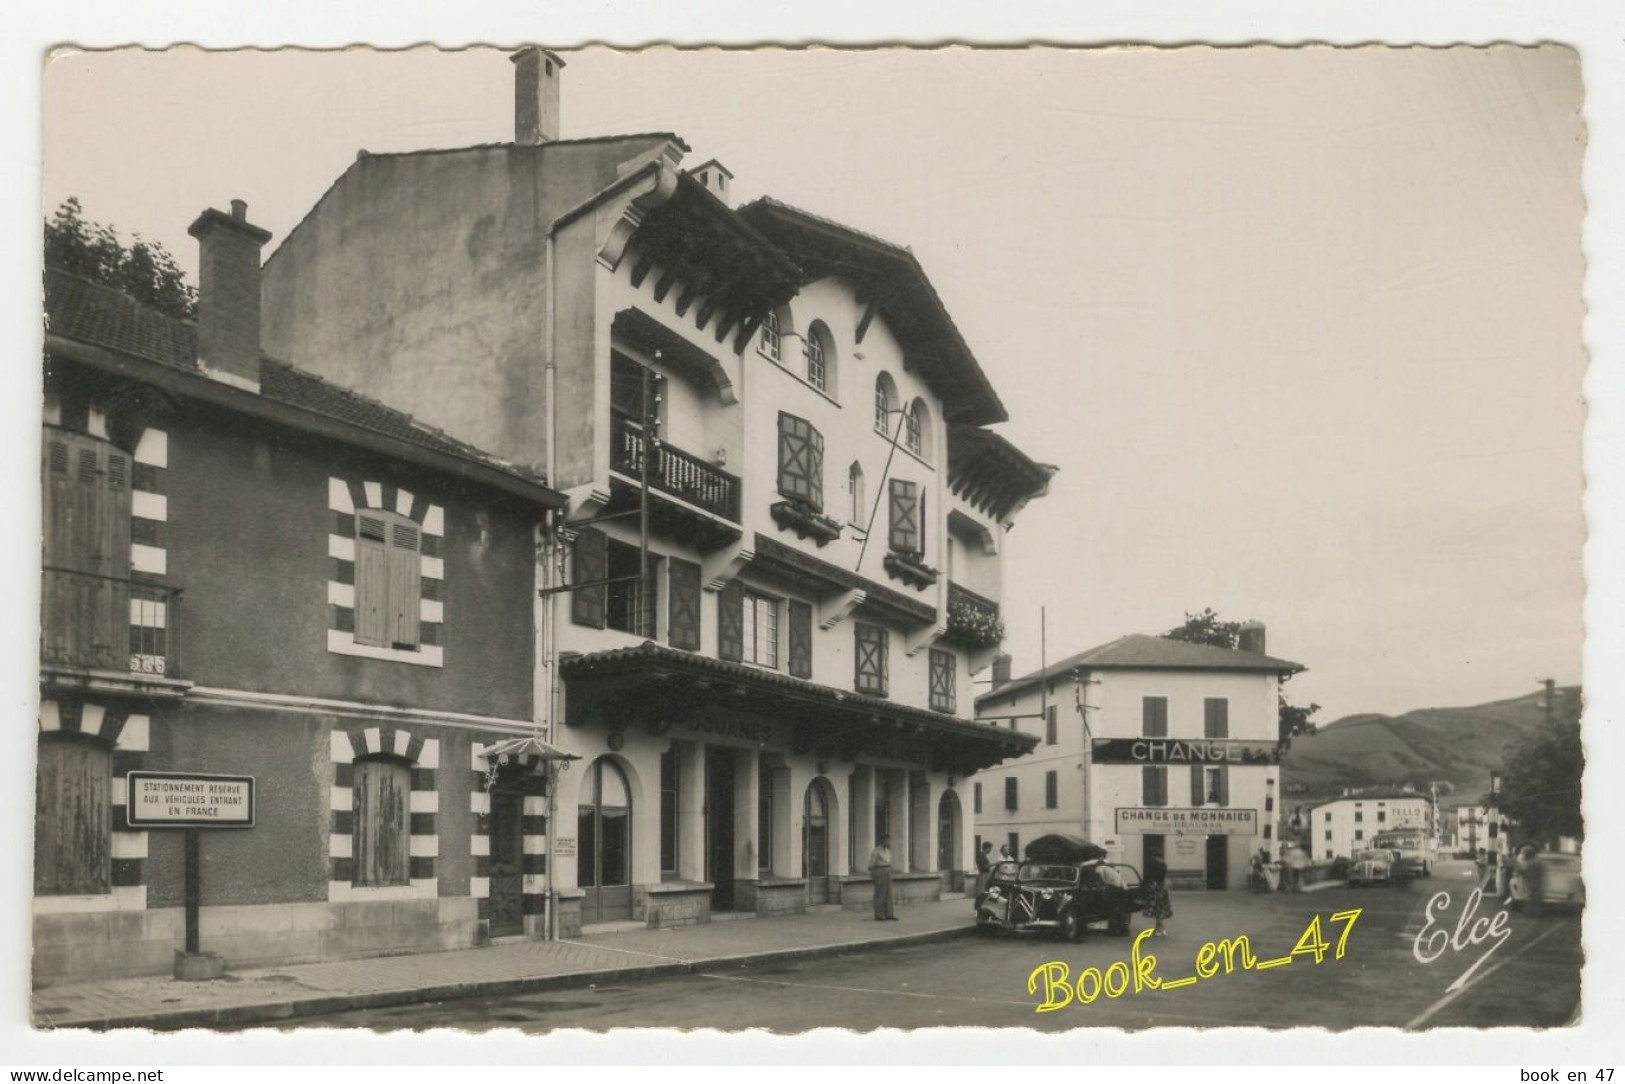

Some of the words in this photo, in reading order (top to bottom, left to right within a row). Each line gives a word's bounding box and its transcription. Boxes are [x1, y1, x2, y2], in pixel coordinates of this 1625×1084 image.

[1131, 741, 1242, 761] CHANGE
[143, 782, 204, 793] STATIONNEMENT
[143, 794, 159, 804] AUX
[210, 796, 242, 805] ENTRANT
[168, 806, 180, 816] EN
[185, 807, 218, 817] FRANCE
[1121, 810, 1169, 821] CHANGE
[1190, 811, 1252, 822] MONNAIES
